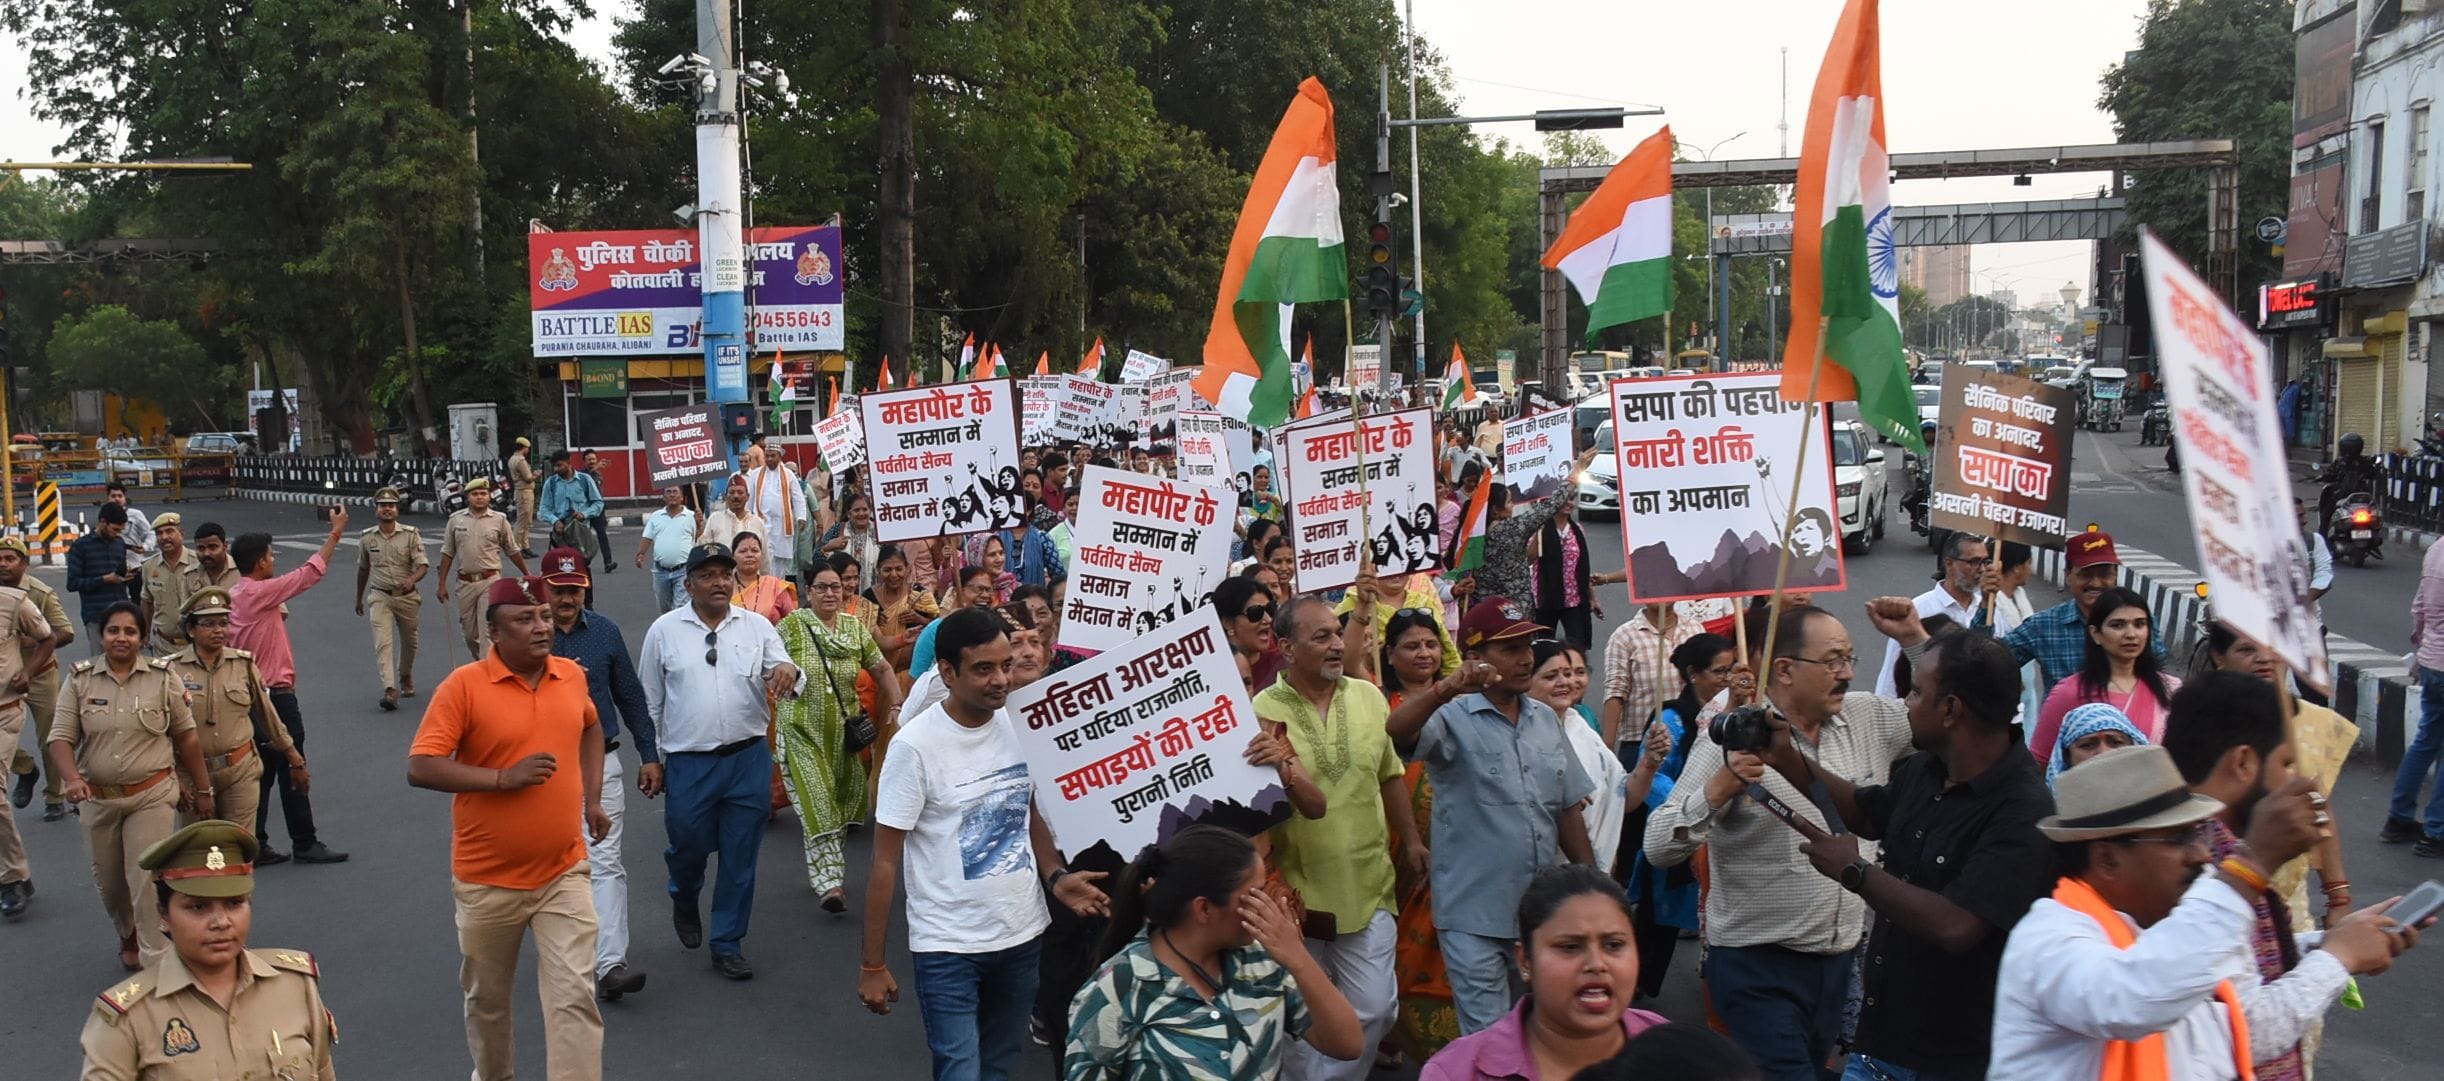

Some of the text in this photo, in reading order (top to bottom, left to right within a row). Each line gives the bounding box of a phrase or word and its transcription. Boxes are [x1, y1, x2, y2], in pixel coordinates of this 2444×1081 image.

[576, 241, 636, 271] पुलिस
[642, 240, 693, 262] चौकी
[609, 268, 684, 289] कोतवाली
[541, 315, 651, 336] BATTLE IAS
[759, 332, 818, 343] Battle IAS
[541, 342, 574, 352] PURANIA
[718, 347, 725, 356] IF
[718, 356, 740, 365] UNSAFE
[879, 384, 993, 425] महापौर के
[1068, 379, 1114, 399] महापौर के
[1620, 391, 1675, 423] सपा
[1680, 380, 1717, 419] की
[1963, 382, 2057, 425] सैनिक परिवार
[653, 413, 707, 430] सैनिक परिवार
[661, 432, 673, 442] का
[897, 418, 983, 449] सम्मान में
[1505, 423, 1523, 439] सपा
[1525, 417, 1537, 433] की
[1971, 417, 2045, 454] का अनादर,
[658, 439, 713, 465] सपा का
[1304, 415, 1414, 462] महापौर के
[1506, 438, 1526, 456] नारी
[1622, 425, 1755, 469] नारी शक्ति
[653, 467, 678, 481] असली
[875, 450, 953, 475] पर्वतीय सैन्य
[1320, 453, 1402, 489] सम्मान में
[1506, 463, 1517, 473] का
[1959, 444, 2052, 500] सपा का
[881, 477, 928, 497] समाज
[1630, 484, 1750, 516] का अपमान
[877, 497, 939, 522] मैदान में
[1102, 480, 1218, 526] महापौर के
[1297, 494, 1338, 517] पर्वतीय
[1933, 491, 2066, 536] असली चेहरा उजागर।
[1113, 521, 1202, 555] सम्मान में
[1303, 518, 1348, 543] समाज
[1080, 544, 1163, 576] पर्वतीय सैन्य
[1298, 540, 1358, 571] मैदान में
[1080, 573, 1131, 599] समाज
[1068, 598, 1136, 630] मैदान में
[1020, 625, 1215, 731] महिला आरक्षण
[1054, 669, 1211, 752] पर घटिया राजनीति,
[1054, 694, 1238, 802] सपाइयों की रही
[1111, 752, 1215, 824] पुरानी निति
